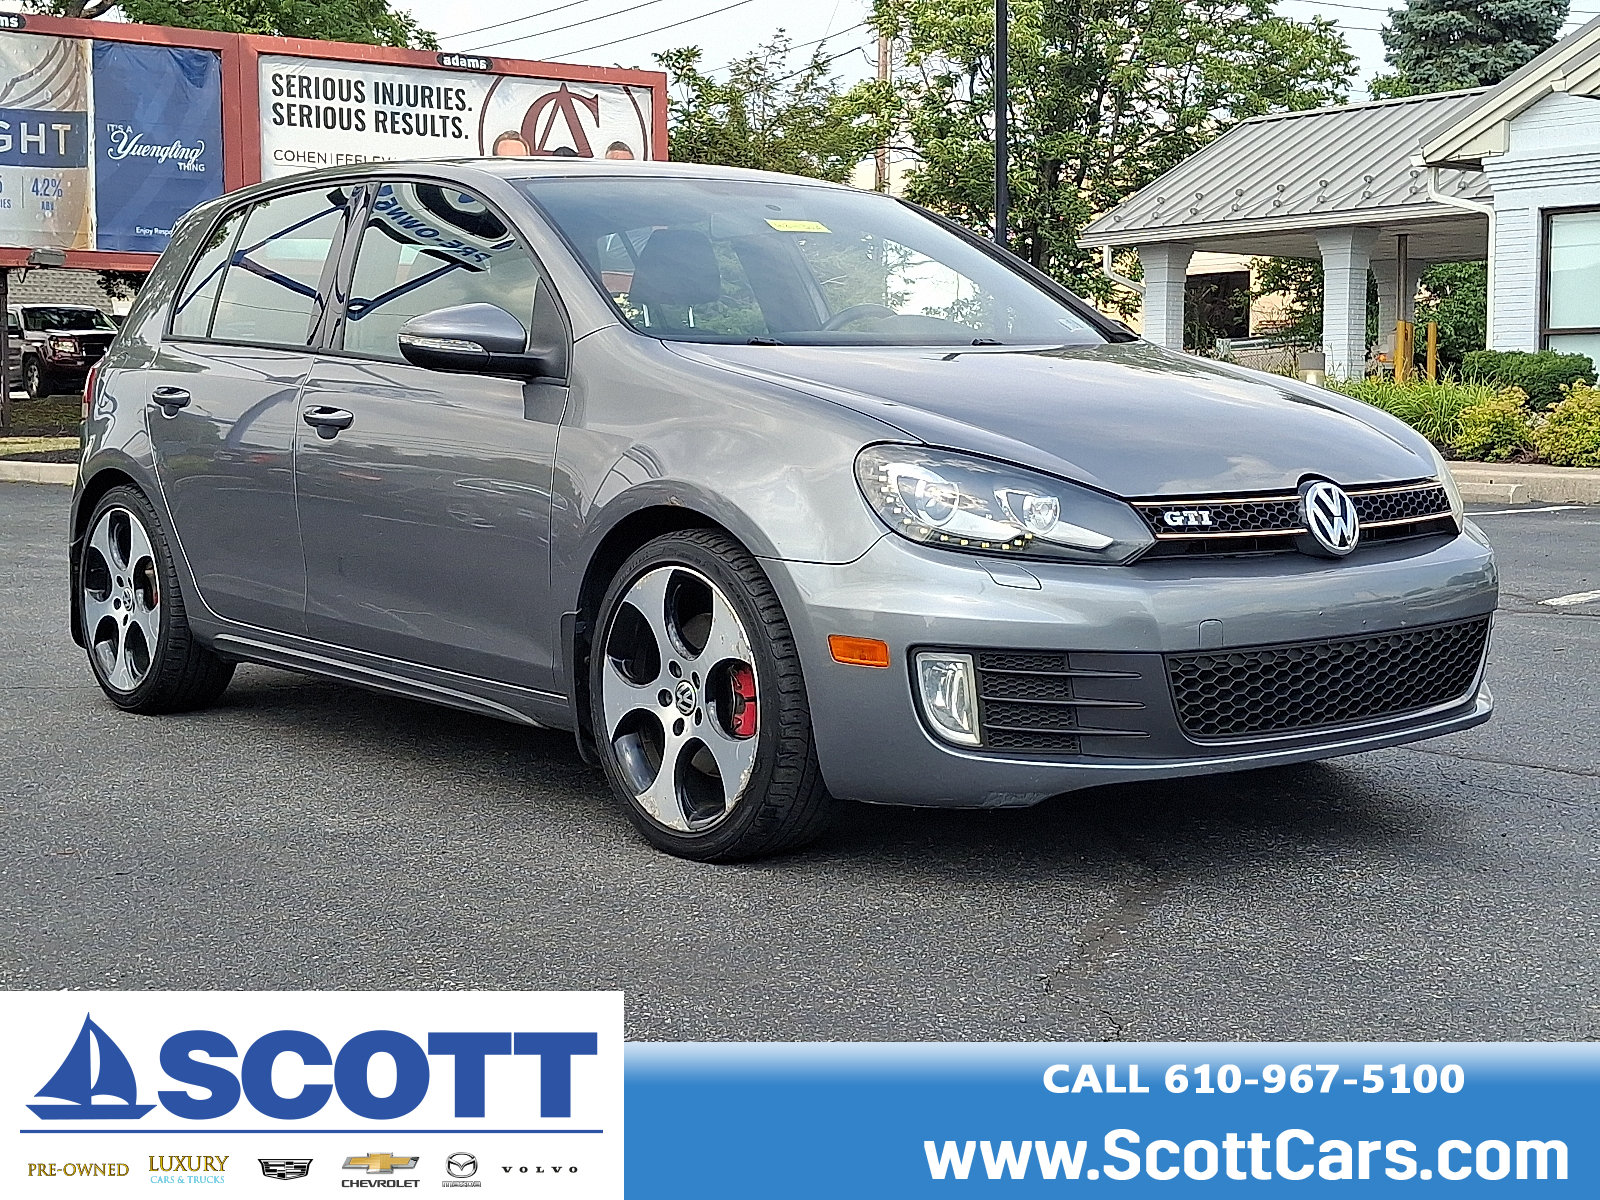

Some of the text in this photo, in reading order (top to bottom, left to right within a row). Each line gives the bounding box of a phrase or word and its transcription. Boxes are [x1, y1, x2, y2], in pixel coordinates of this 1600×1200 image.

[443, 55, 487, 70] adams
[271, 73, 473, 112] SERIOUS INJURIES.
[272, 102, 470, 140] SERIOUS RESULTS.
[126, 125, 134, 134] A
[107, 133, 205, 164] Yuengling
[273, 149, 327, 164] COHEN
[177, 161, 205, 172] THING
[31, 178, 63, 197] 4.2%
[136, 226, 153, 235] Enjoy
[1163, 510, 1213, 527] GTI
